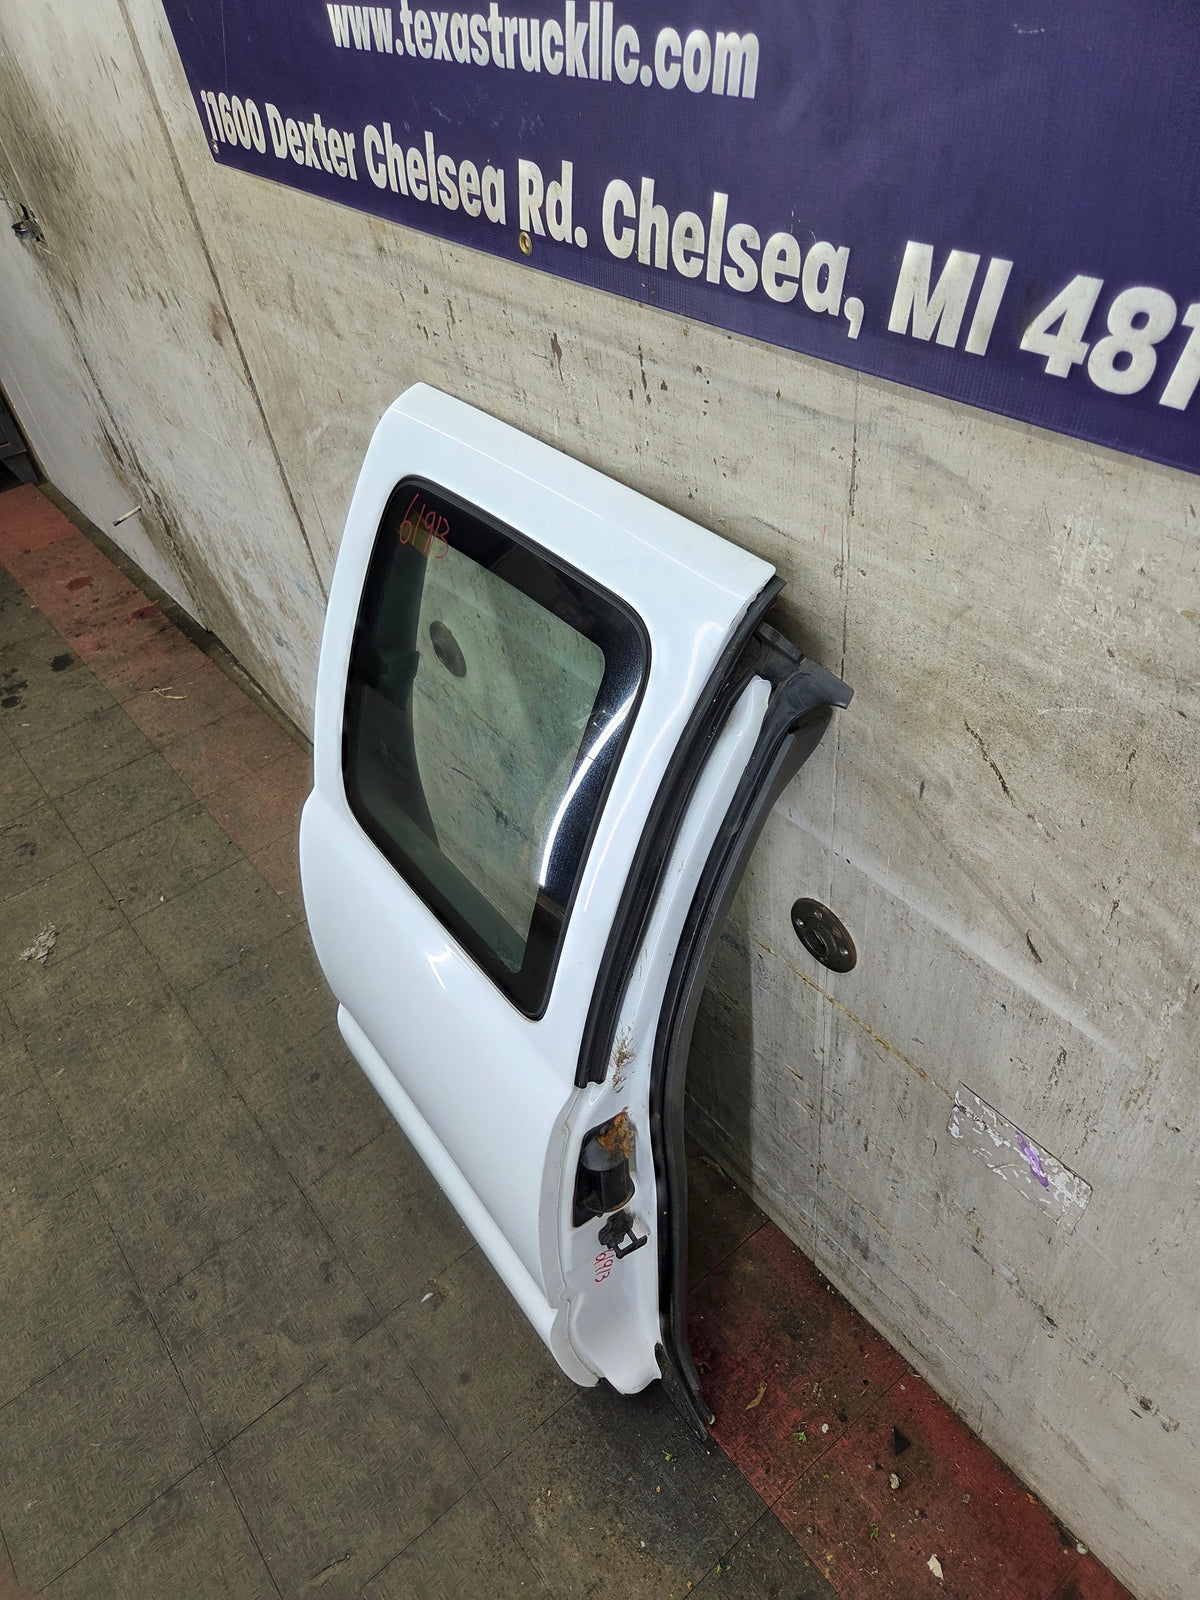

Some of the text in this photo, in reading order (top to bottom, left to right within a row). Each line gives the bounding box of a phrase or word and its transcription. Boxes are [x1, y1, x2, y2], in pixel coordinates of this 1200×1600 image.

[326, 0, 760, 99] www.texastruckllc.com
[200, 89, 267, 154] 11600
[264, 102, 358, 181] Dexter
[362, 122, 507, 225] Chelsea
[518, 158, 589, 249] Rd.
[602, 178, 865, 340] Chelsea,
[887, 240, 1015, 357] MI
